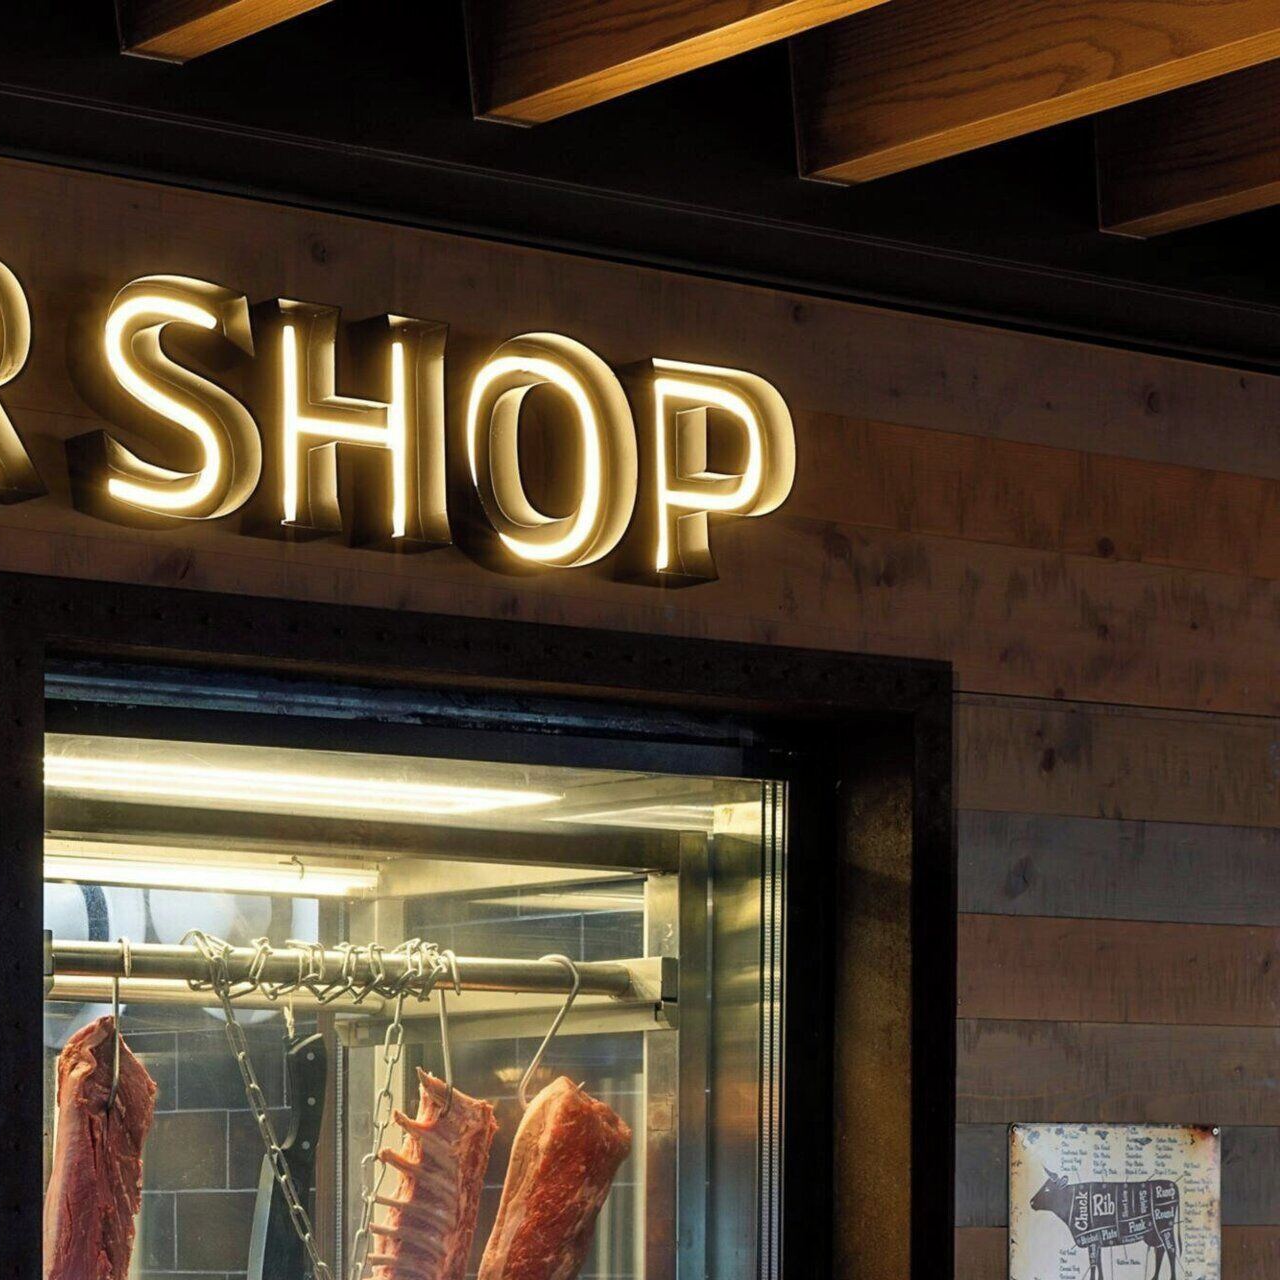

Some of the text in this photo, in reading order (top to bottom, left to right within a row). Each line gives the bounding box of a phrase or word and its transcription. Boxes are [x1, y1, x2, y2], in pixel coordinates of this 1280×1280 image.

[72, 273, 797, 580] SHOP
[1074, 1191, 1088, 1231] Chuck
[1093, 1193, 1115, 1216] Rib
